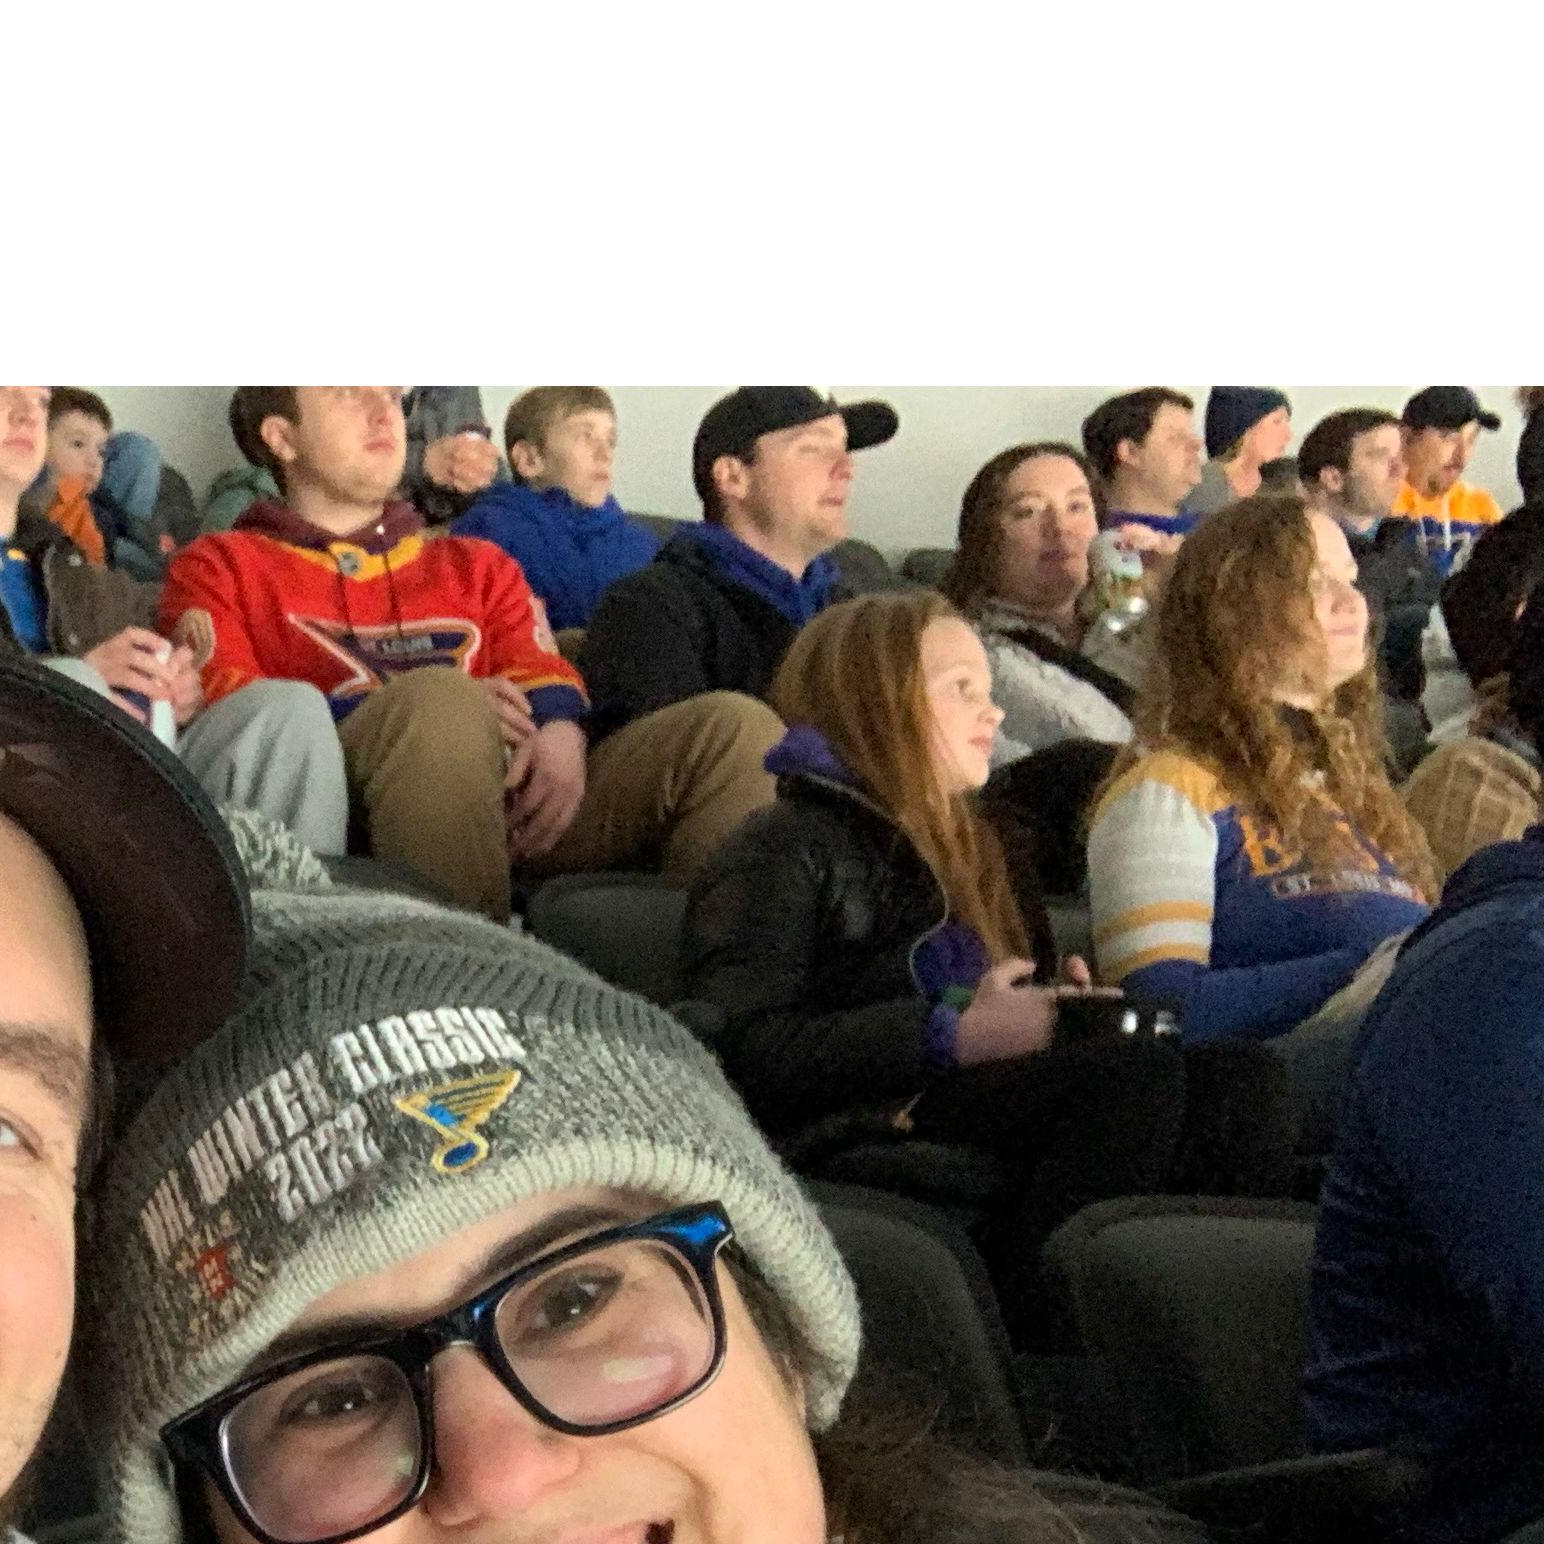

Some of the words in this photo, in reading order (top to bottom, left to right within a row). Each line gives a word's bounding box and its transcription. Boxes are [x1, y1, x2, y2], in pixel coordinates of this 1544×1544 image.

[187, 1051, 331, 1206] WINTER
[330, 1006, 526, 1093] CLASSIC
[263, 1103, 384, 1222] 2022
